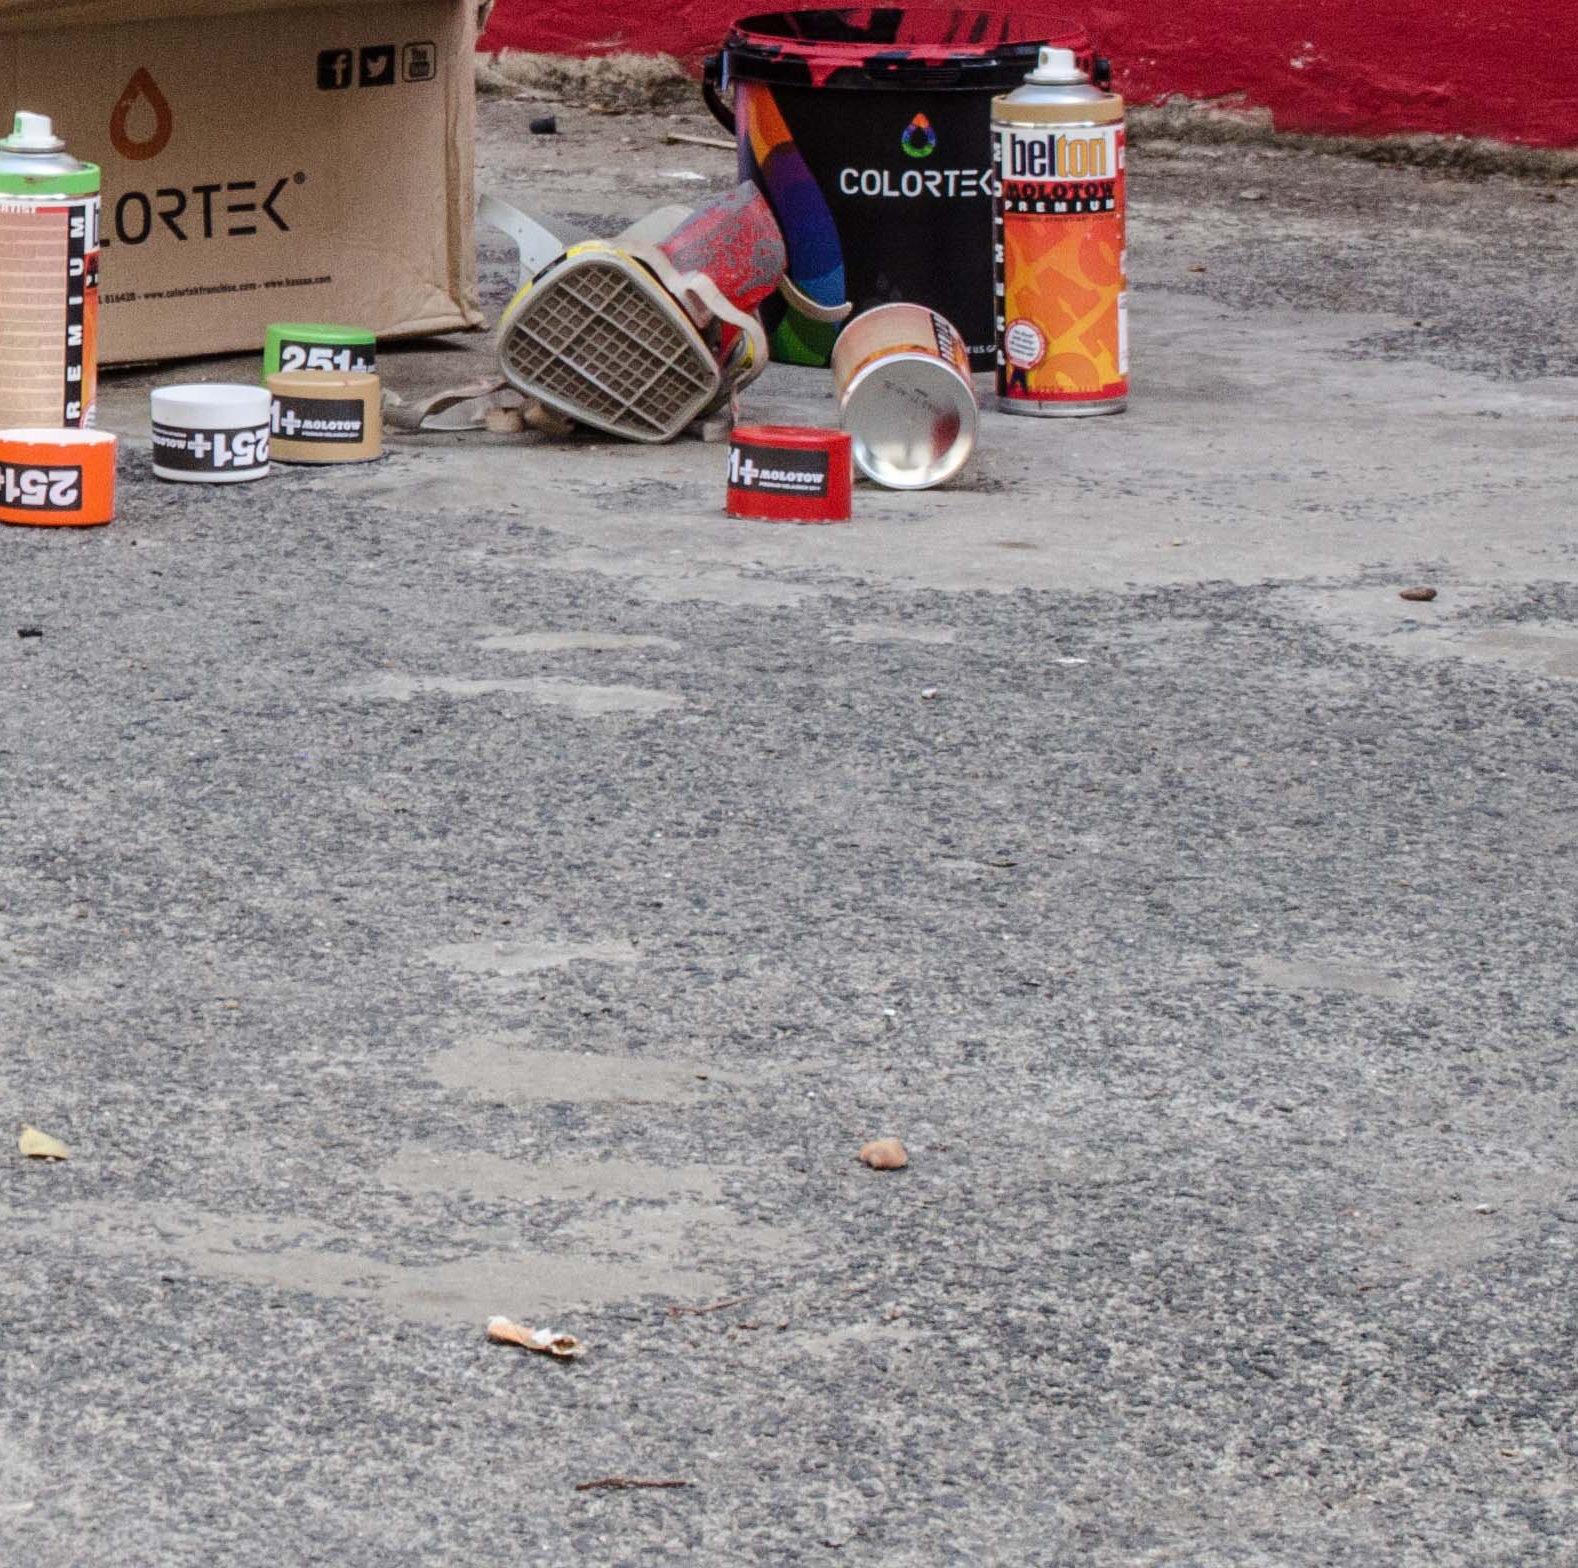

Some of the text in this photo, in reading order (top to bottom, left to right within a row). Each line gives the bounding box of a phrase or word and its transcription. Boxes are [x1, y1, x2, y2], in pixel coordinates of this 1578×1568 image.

[1010, 133, 1107, 177] belton
[839, 168, 994, 198] COLORTEK
[1006, 181, 1116, 199] MOLOTOW
[1005, 198, 1115, 213] PREMIUM
[65, 216, 85, 420] REMIUM
[302, 420, 362, 431] MOLOTOW
[187, 427, 269, 467] 251+
[760, 469, 825, 483] MOLOTOW
